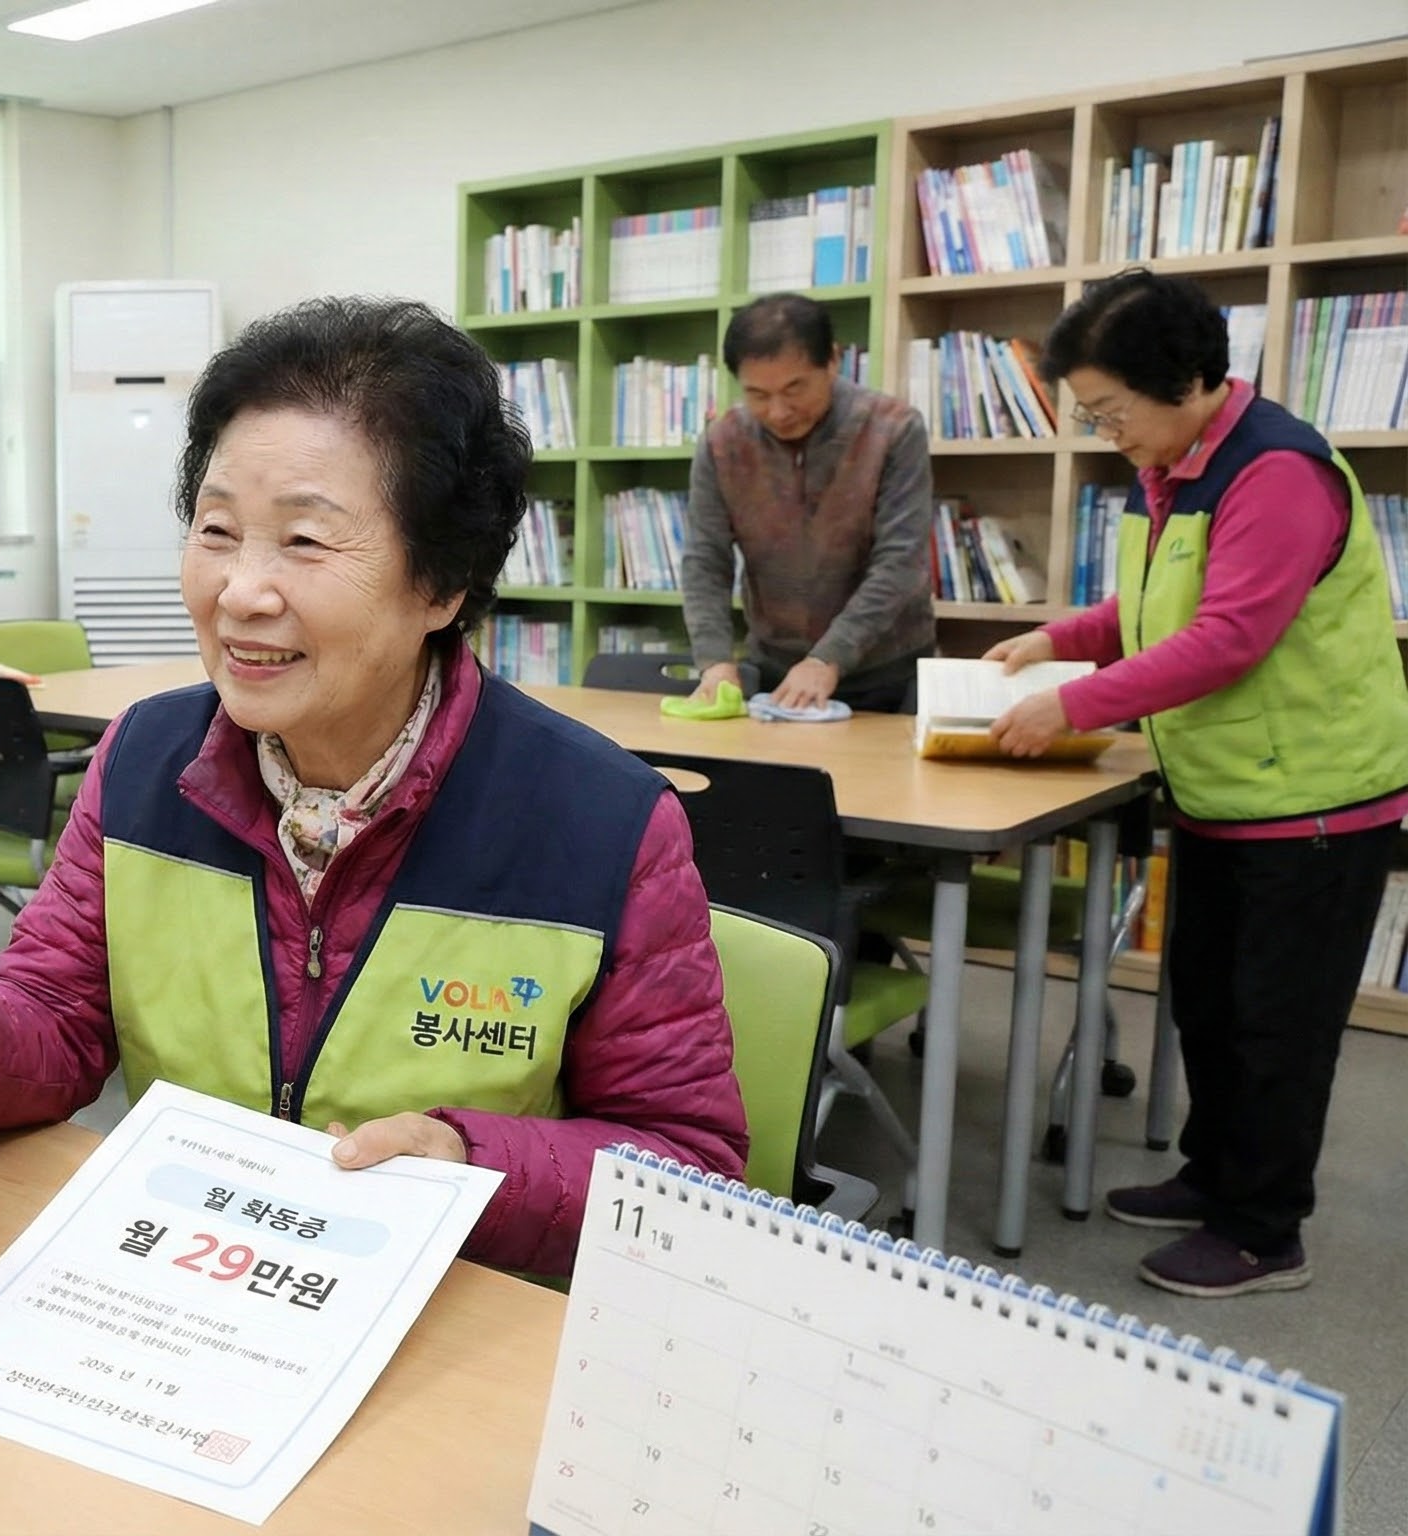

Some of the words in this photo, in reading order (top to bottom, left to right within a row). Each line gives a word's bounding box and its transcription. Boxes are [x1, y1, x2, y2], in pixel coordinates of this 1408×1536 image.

[410, 1011, 537, 1060] 봉사센터
[203, 1187, 236, 1212] 월
[612, 1198, 644, 1239] 11
[119, 1220, 168, 1257] 월
[172, 1233, 339, 1311] 29만원
[589, 1306, 600, 1321] 2
[664, 1338, 674, 1352] 6
[748, 1371, 758, 1386] 7
[833, 1408, 843, 1424] 8
[927, 1448, 939, 1463] 9
[939, 1387, 952, 1405] 2
[570, 1410, 585, 1428] 16
[645, 1445, 662, 1462] 19
[723, 1482, 740, 1500] 21
[578, 1358, 588, 1371] 9
[738, 1426, 753, 1444] 14
[824, 1466, 841, 1486] 15
[917, 1507, 936, 1528] 16
[558, 1460, 575, 1478] 25
[632, 1498, 650, 1515] 27
